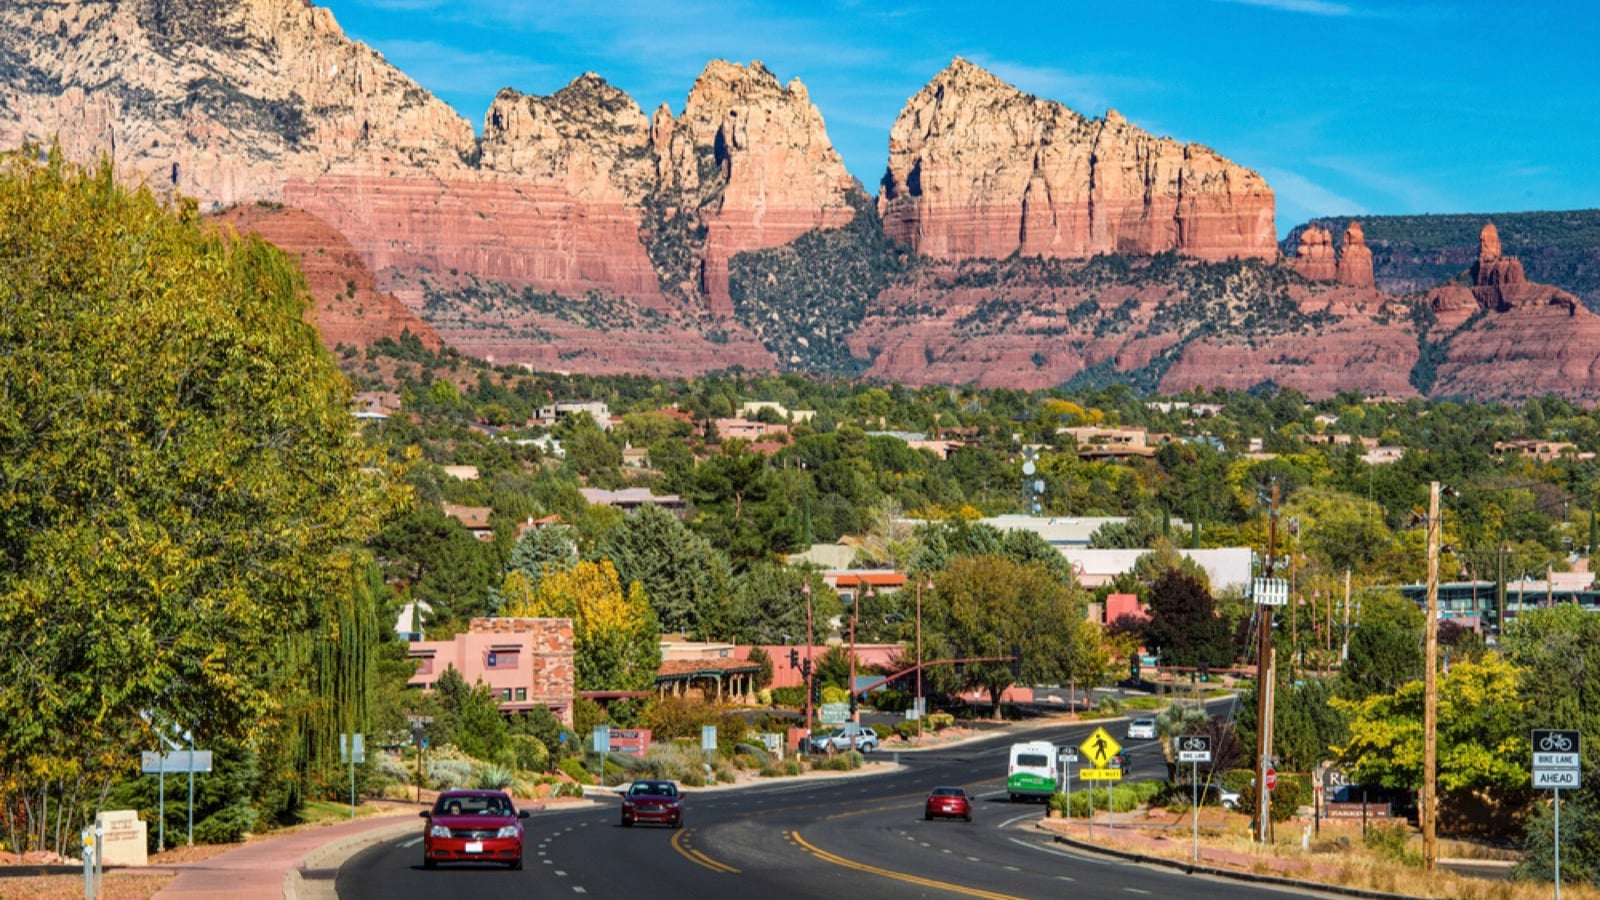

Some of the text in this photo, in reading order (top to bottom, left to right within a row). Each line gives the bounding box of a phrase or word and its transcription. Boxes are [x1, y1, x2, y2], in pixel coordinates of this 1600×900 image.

[1538, 755, 1573, 763] BIKE LANE
[1540, 773, 1573, 783] AHEAD
